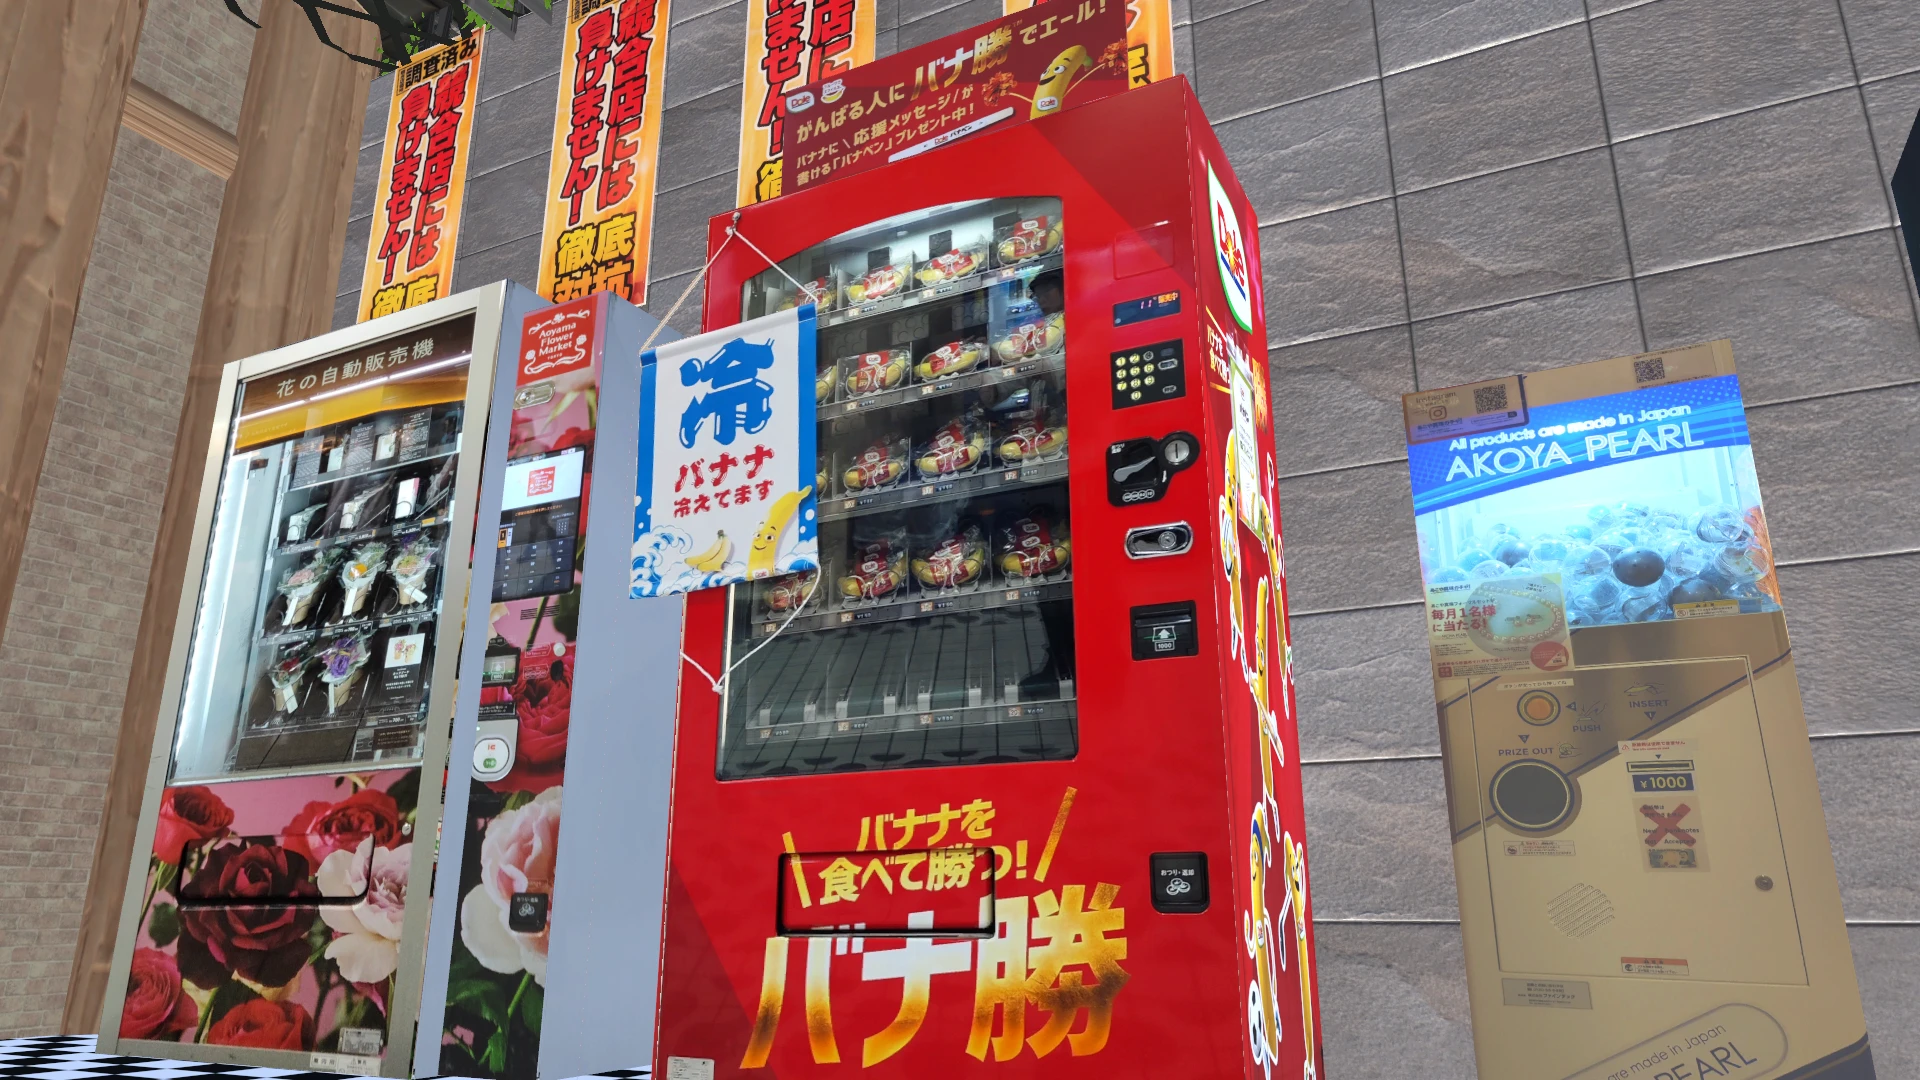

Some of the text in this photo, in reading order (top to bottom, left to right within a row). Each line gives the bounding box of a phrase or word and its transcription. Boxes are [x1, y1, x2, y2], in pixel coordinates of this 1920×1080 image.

[403, 38, 477, 89] 調査済み
[791, 95, 811, 106] Dole
[796, 82, 905, 144] がんばる人に
[909, 27, 1013, 101] バナ勝
[1040, 99, 1056, 107] Dole
[796, 143, 839, 168] バナナに
[934, 135, 949, 145] Dole
[555, 211, 637, 279] 徹底
[1215, 200, 1245, 286] Dole
[370, 274, 438, 320] 徹底
[539, 322, 576, 339] Aoyama
[539, 340, 572, 356] Market
[541, 332, 573, 347] Flower
[276, 338, 434, 398] 花の自動販売機
[1416, 392, 1456, 404] Instagram
[1449, 405, 1691, 451] All products are made in Japan
[674, 444, 775, 493] バナナ
[1446, 421, 1704, 481] AKOYA PEARL
[673, 479, 774, 518] 冷えてます
[1432, 604, 1496, 620] 毎月1名様
[1433, 618, 1487, 632] に当たる!
[1629, 700, 1668, 708] INSERT
[1498, 747, 1553, 757] PRIZE OUT
[1640, 776, 1687, 789] ¥1000
[857, 798, 996, 853] バナナを
[818, 839, 1028, 906] 食べて勝つ!
[740, 881, 1131, 1069] バナ勝
[1630, 1050, 1669, 1074] made
[1667, 1043, 1684, 1056] in
[1687, 1024, 1727, 1050] Japan
